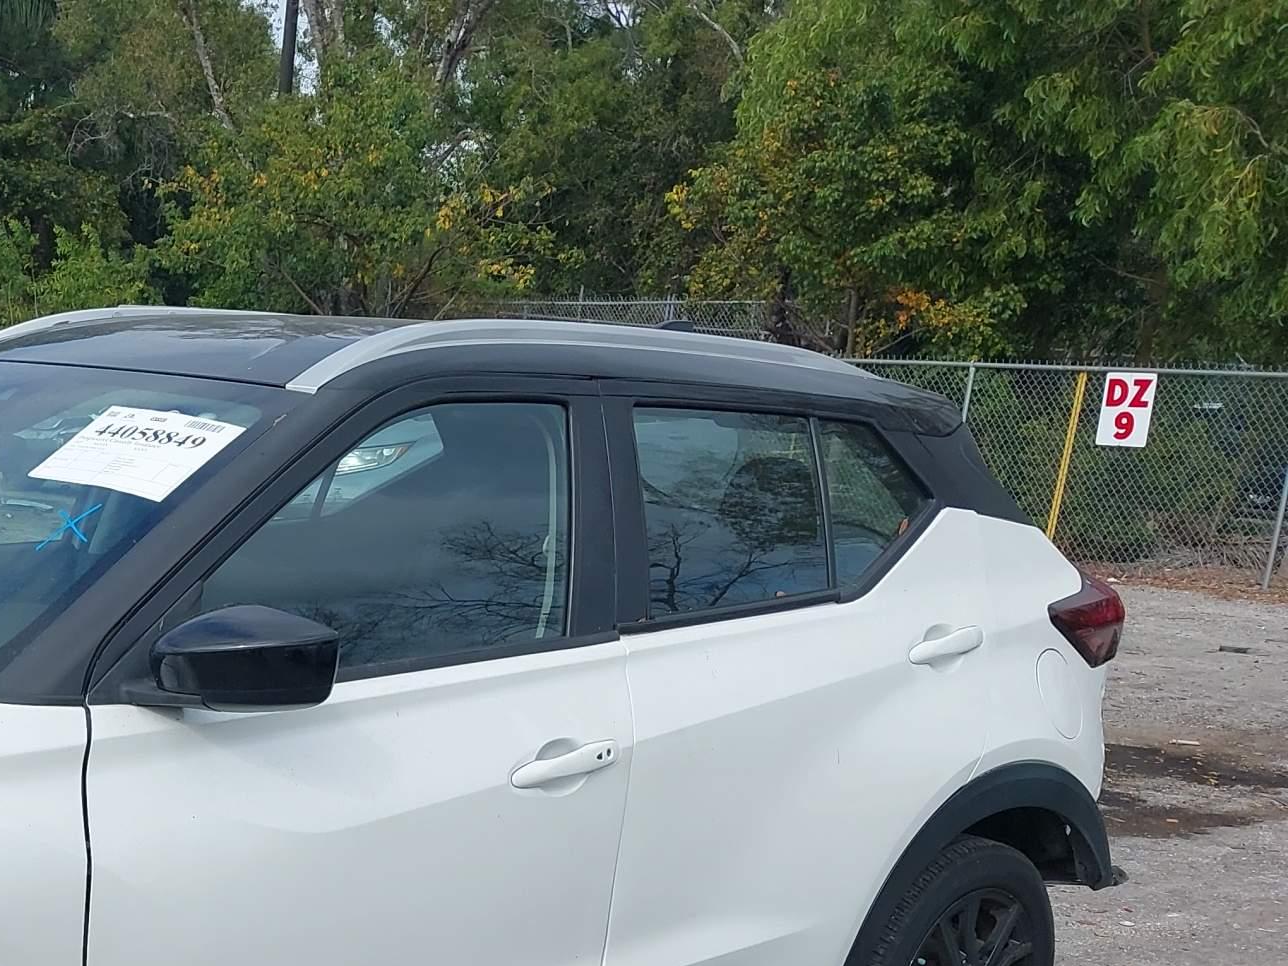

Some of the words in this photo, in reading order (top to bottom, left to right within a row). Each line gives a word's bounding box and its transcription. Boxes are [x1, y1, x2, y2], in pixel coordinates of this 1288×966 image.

[1106, 378, 1153, 407] DZ
[95, 423, 207, 449] 44058849
[1113, 412, 1134, 440] 9
